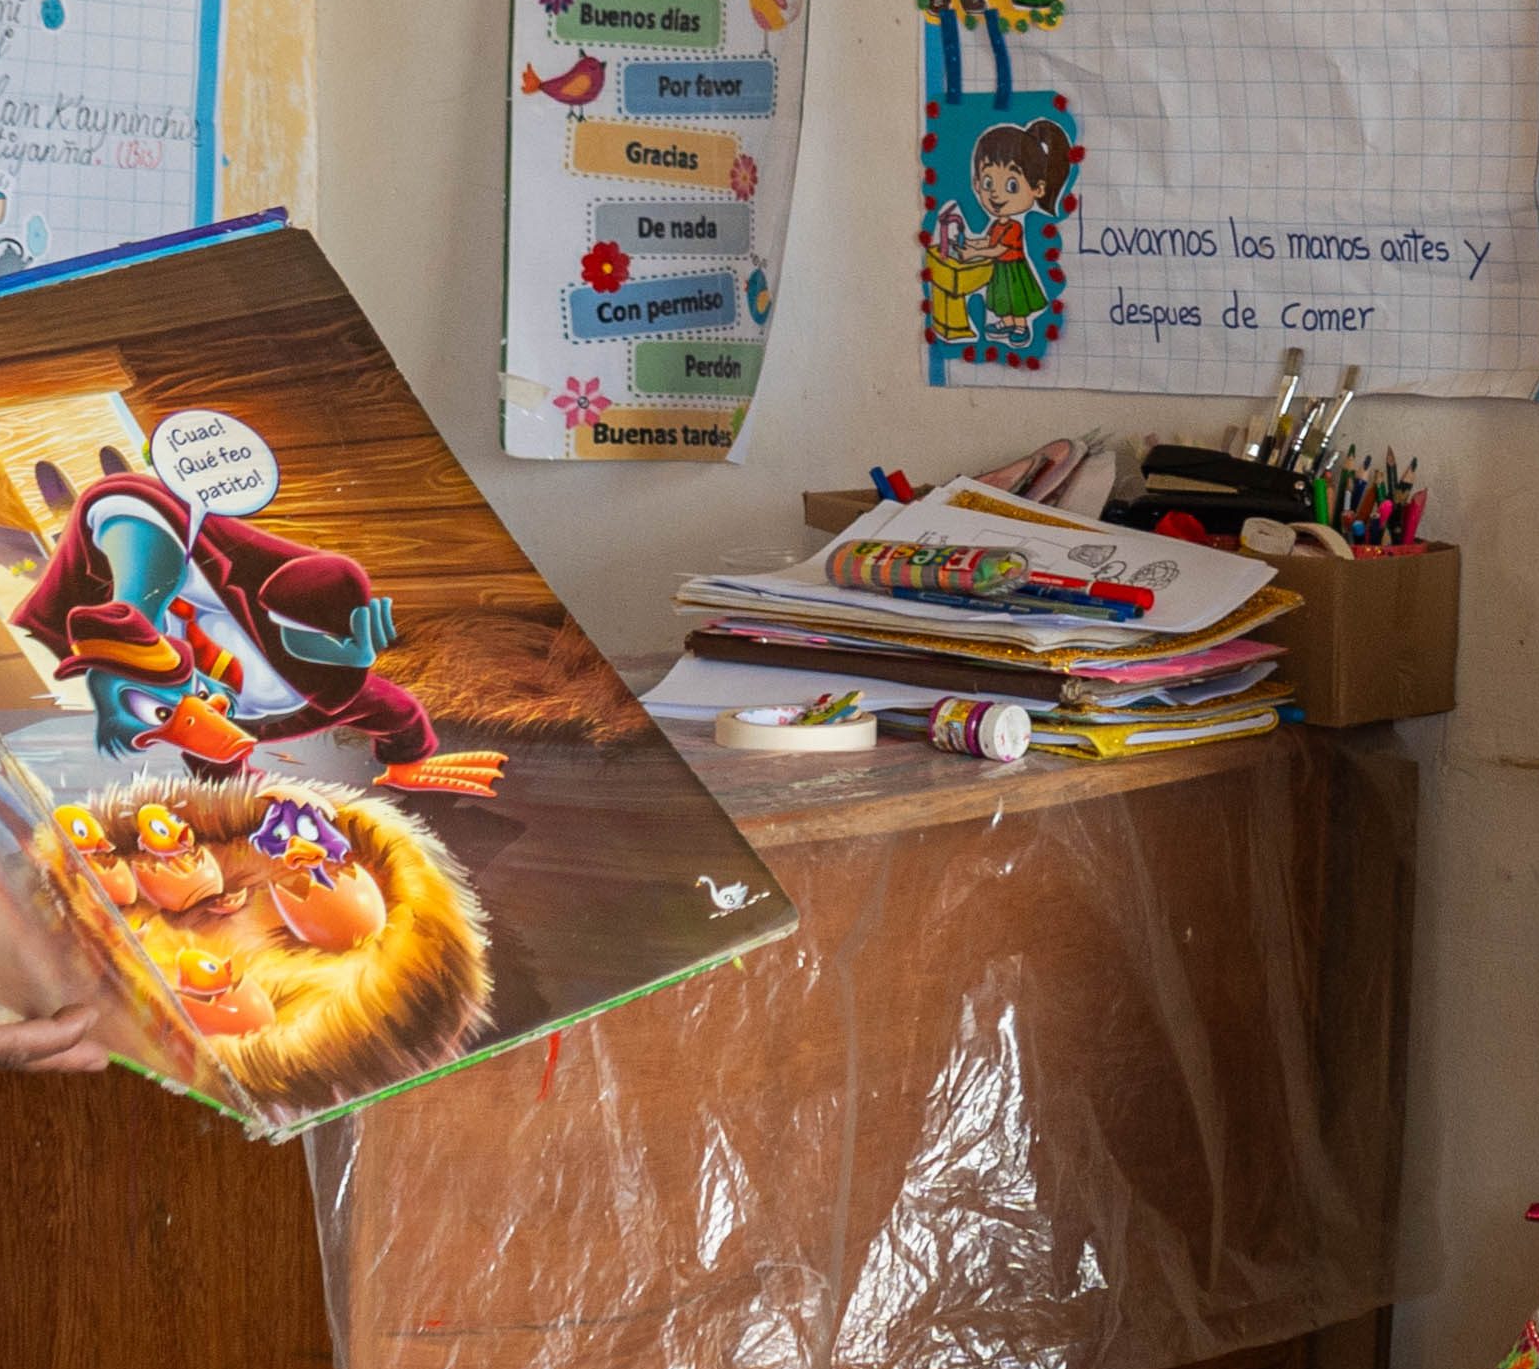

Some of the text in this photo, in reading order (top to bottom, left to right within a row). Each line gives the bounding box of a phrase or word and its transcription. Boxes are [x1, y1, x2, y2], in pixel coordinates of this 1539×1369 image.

[579, 1, 702, 33] Buenos días
[658, 74, 743, 98] Por favor
[625, 142, 699, 170] Gracias
[638, 217, 718, 240] De nada
[1076, 194, 1490, 280] Lavarnos las manos antes y
[598, 290, 723, 325] Con permiso
[1110, 290, 1202, 343] despues
[1222, 291, 1259, 330] de
[684, 353, 742, 380] Perdón
[166, 418, 227, 453] ¡Cuac!
[592, 421, 676, 448] Buenas
[174, 444, 252, 485] ¡Qué feo
[197, 469, 266, 509] patito!
